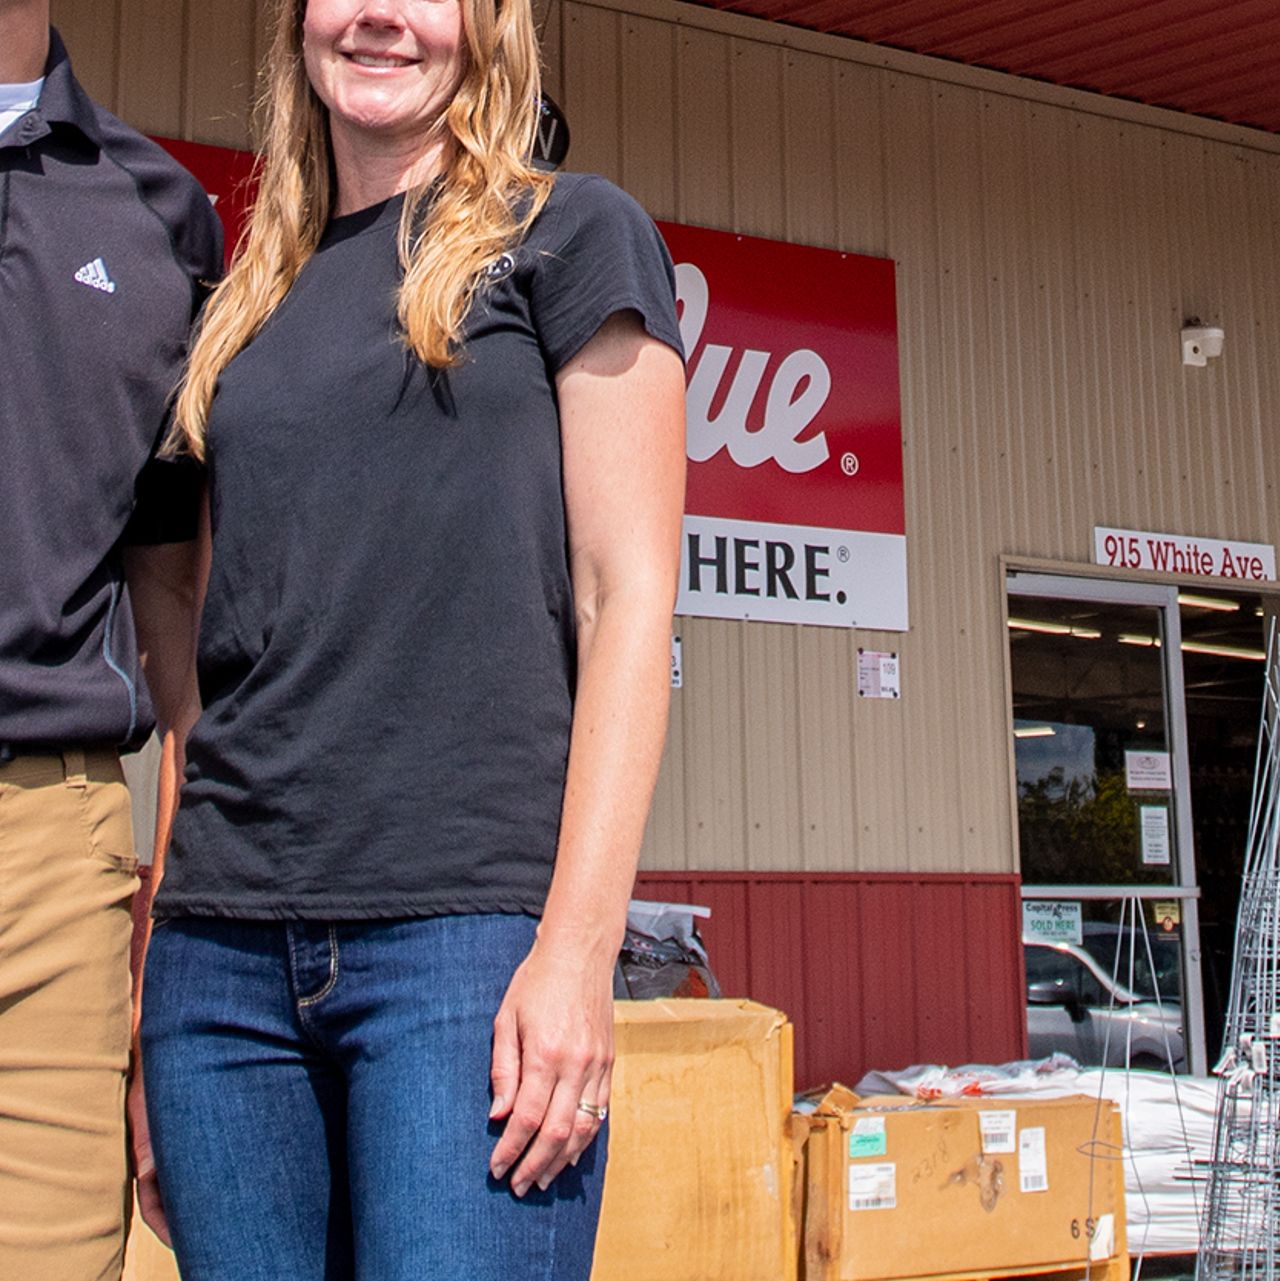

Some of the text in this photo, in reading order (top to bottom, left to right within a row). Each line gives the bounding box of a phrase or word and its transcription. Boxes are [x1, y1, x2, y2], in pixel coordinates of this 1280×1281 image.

[74, 270, 116, 293] adidas
[1105, 535, 1268, 581] 915 White Ave.
